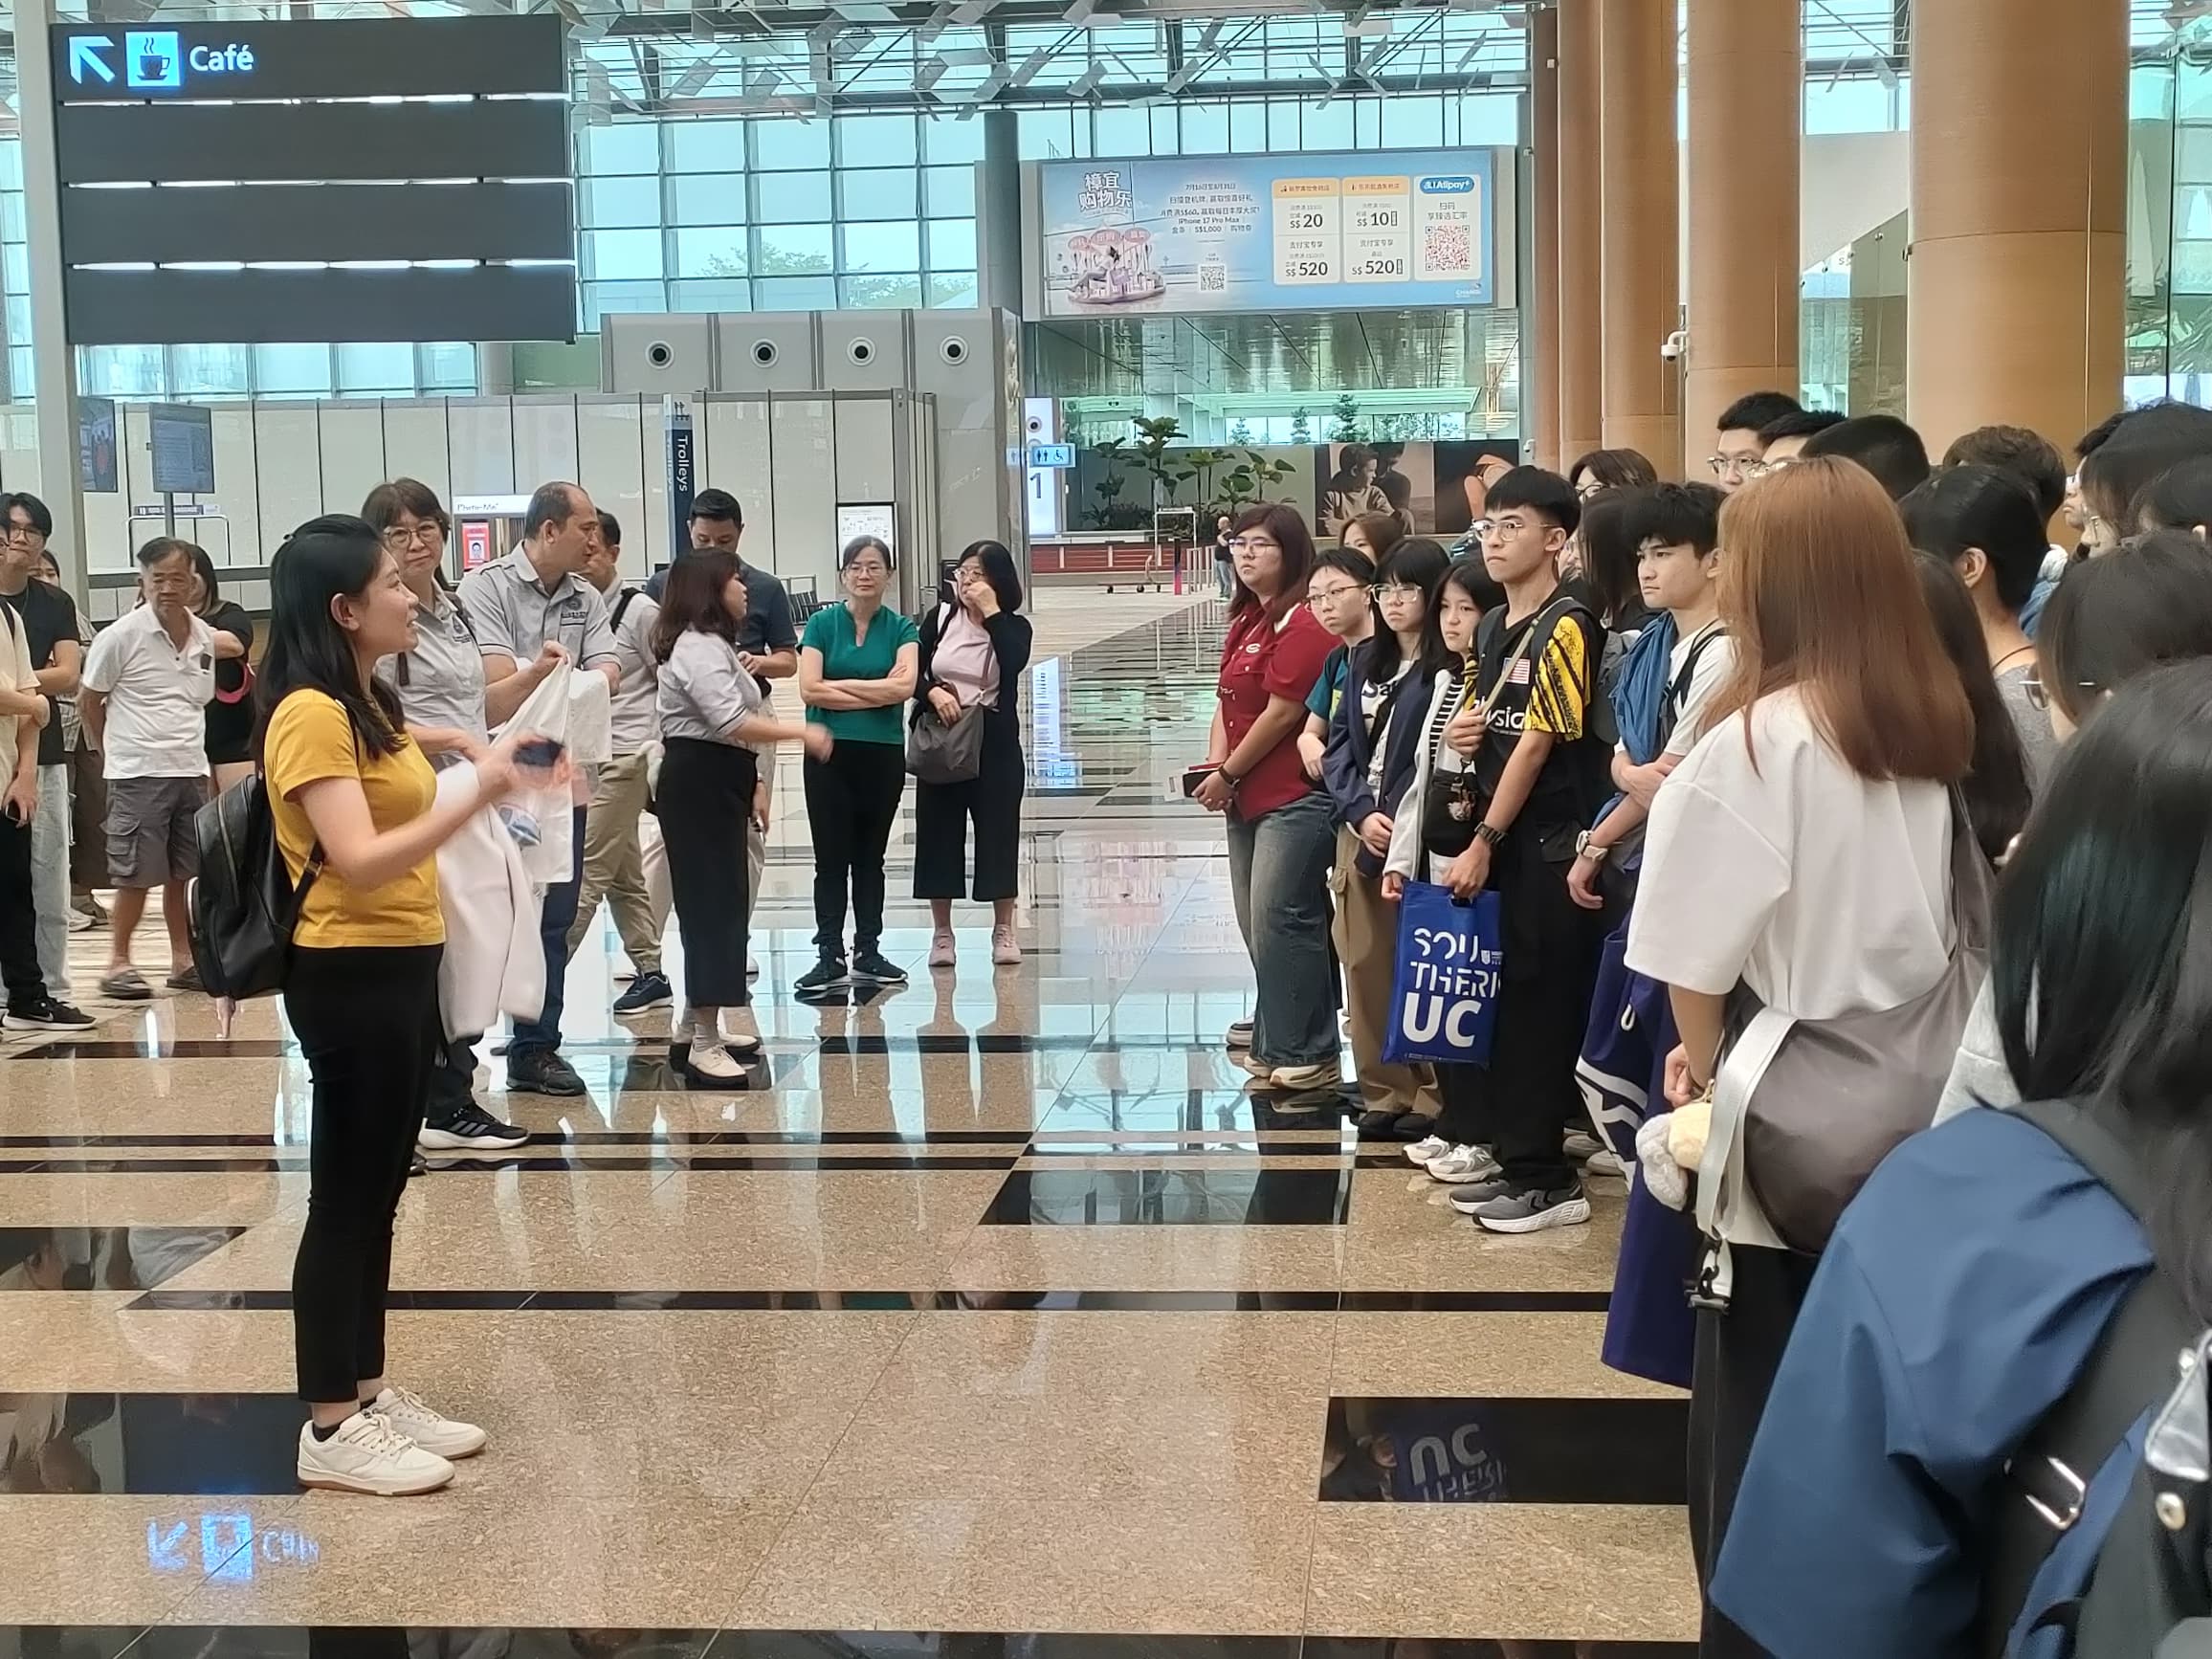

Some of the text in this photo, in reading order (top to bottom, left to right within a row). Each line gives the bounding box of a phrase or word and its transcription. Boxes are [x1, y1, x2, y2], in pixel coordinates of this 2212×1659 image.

[189, 44, 254, 72] Café
[1084, 171, 1121, 191] 樟宜
[1078, 189, 1133, 211] 购物乐
[1303, 213, 1323, 228] 20
[1370, 212, 1389, 226] 10
[1298, 261, 1329, 276] 520
[1364, 259, 1395, 275] 520
[676, 434, 690, 492] Trolleys
[1029, 472, 1042, 499] 1
[1403, 991, 1483, 1049] UC
